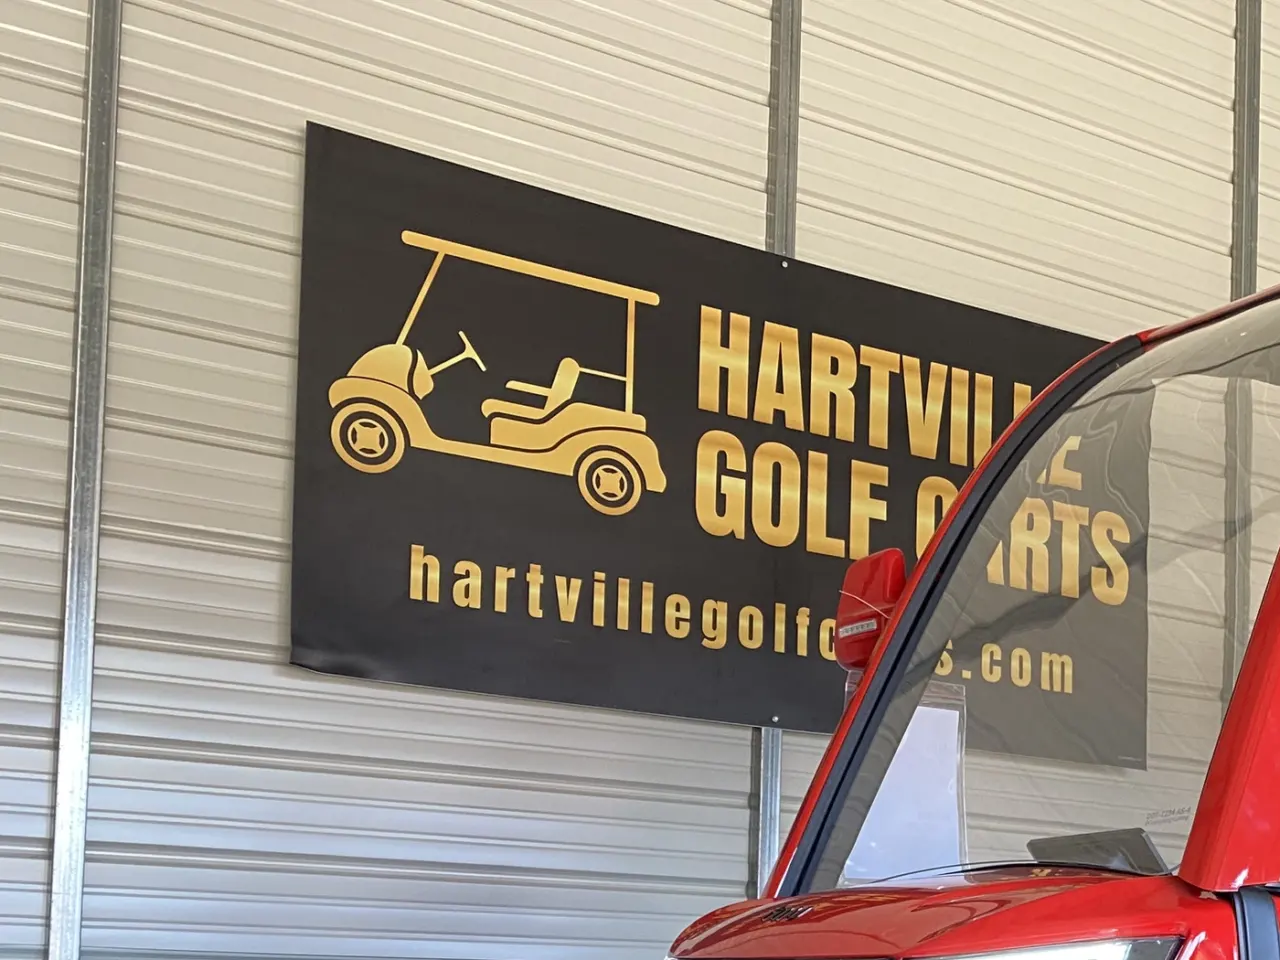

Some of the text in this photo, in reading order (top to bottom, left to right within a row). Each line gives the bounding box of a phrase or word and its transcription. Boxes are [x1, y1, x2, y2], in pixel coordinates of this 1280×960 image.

[694, 429, 1131, 606] GOLF CRTS
[409, 543, 1073, 695] hartvillegolfcs.com
